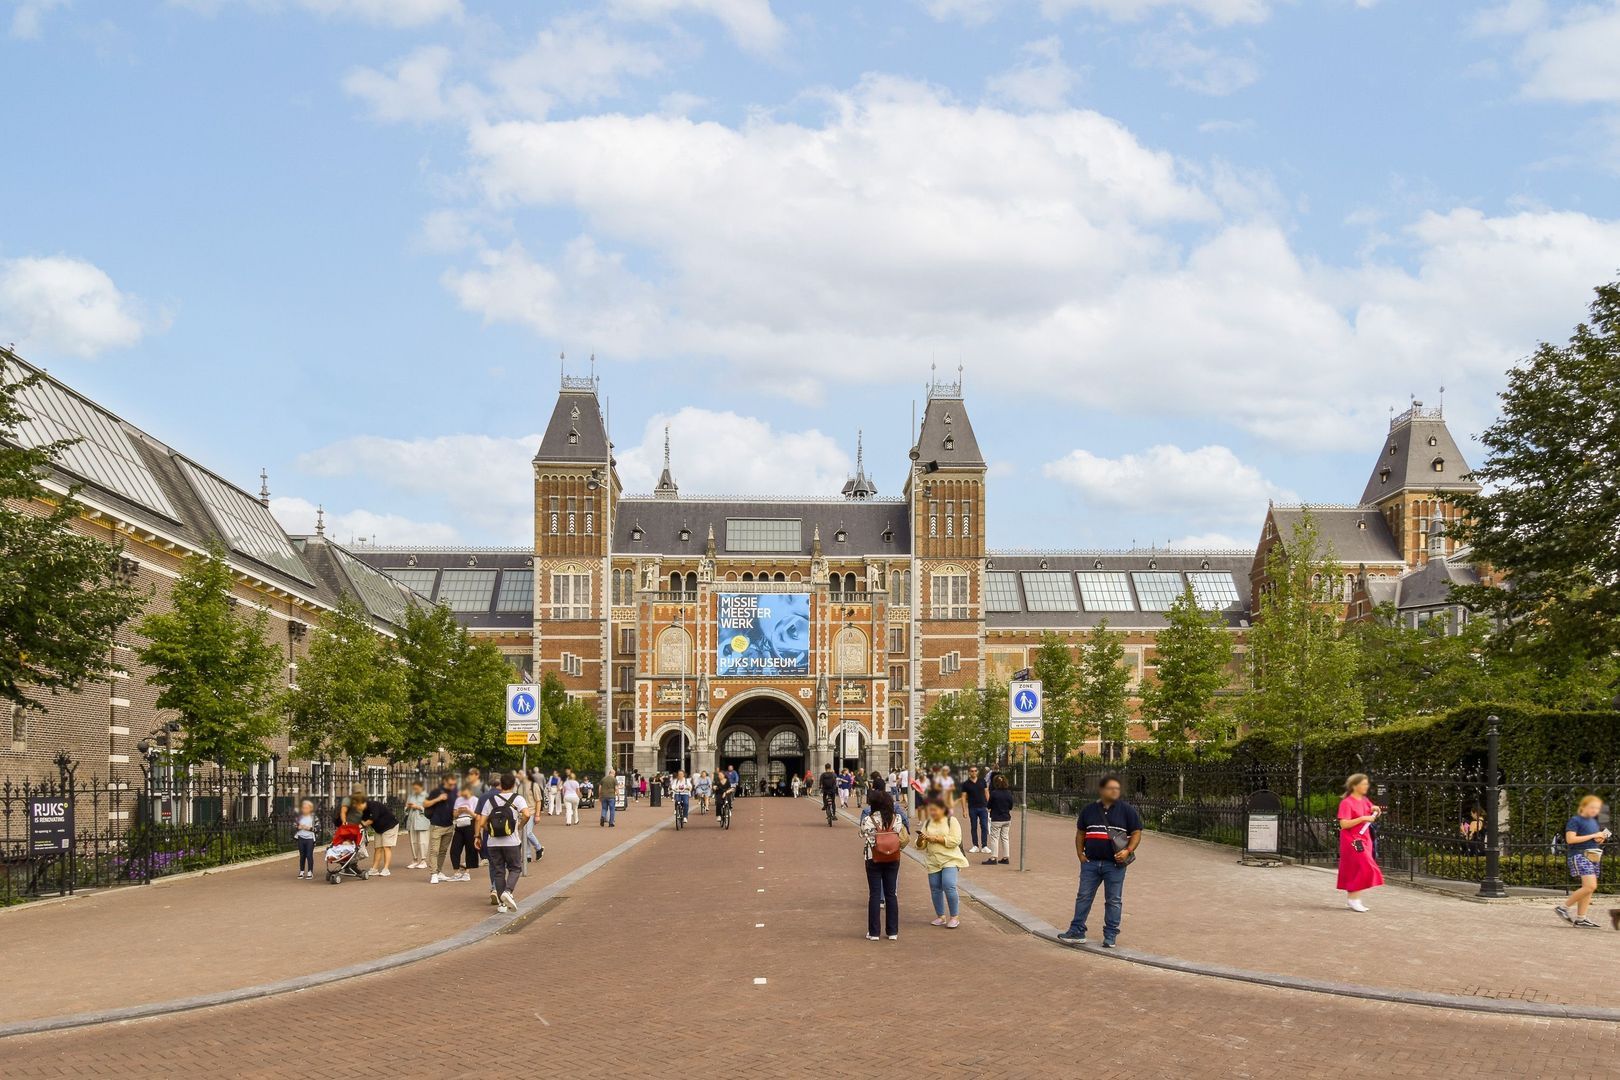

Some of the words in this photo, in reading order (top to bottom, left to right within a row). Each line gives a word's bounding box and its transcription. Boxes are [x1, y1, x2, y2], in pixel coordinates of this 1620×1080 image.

[721, 597, 758, 607] MISSIE
[721, 608, 771, 618] MEESTER
[720, 618, 754, 628] WERK
[750, 658, 796, 667] MUSEUM
[34, 803, 64, 816] RIJKS
